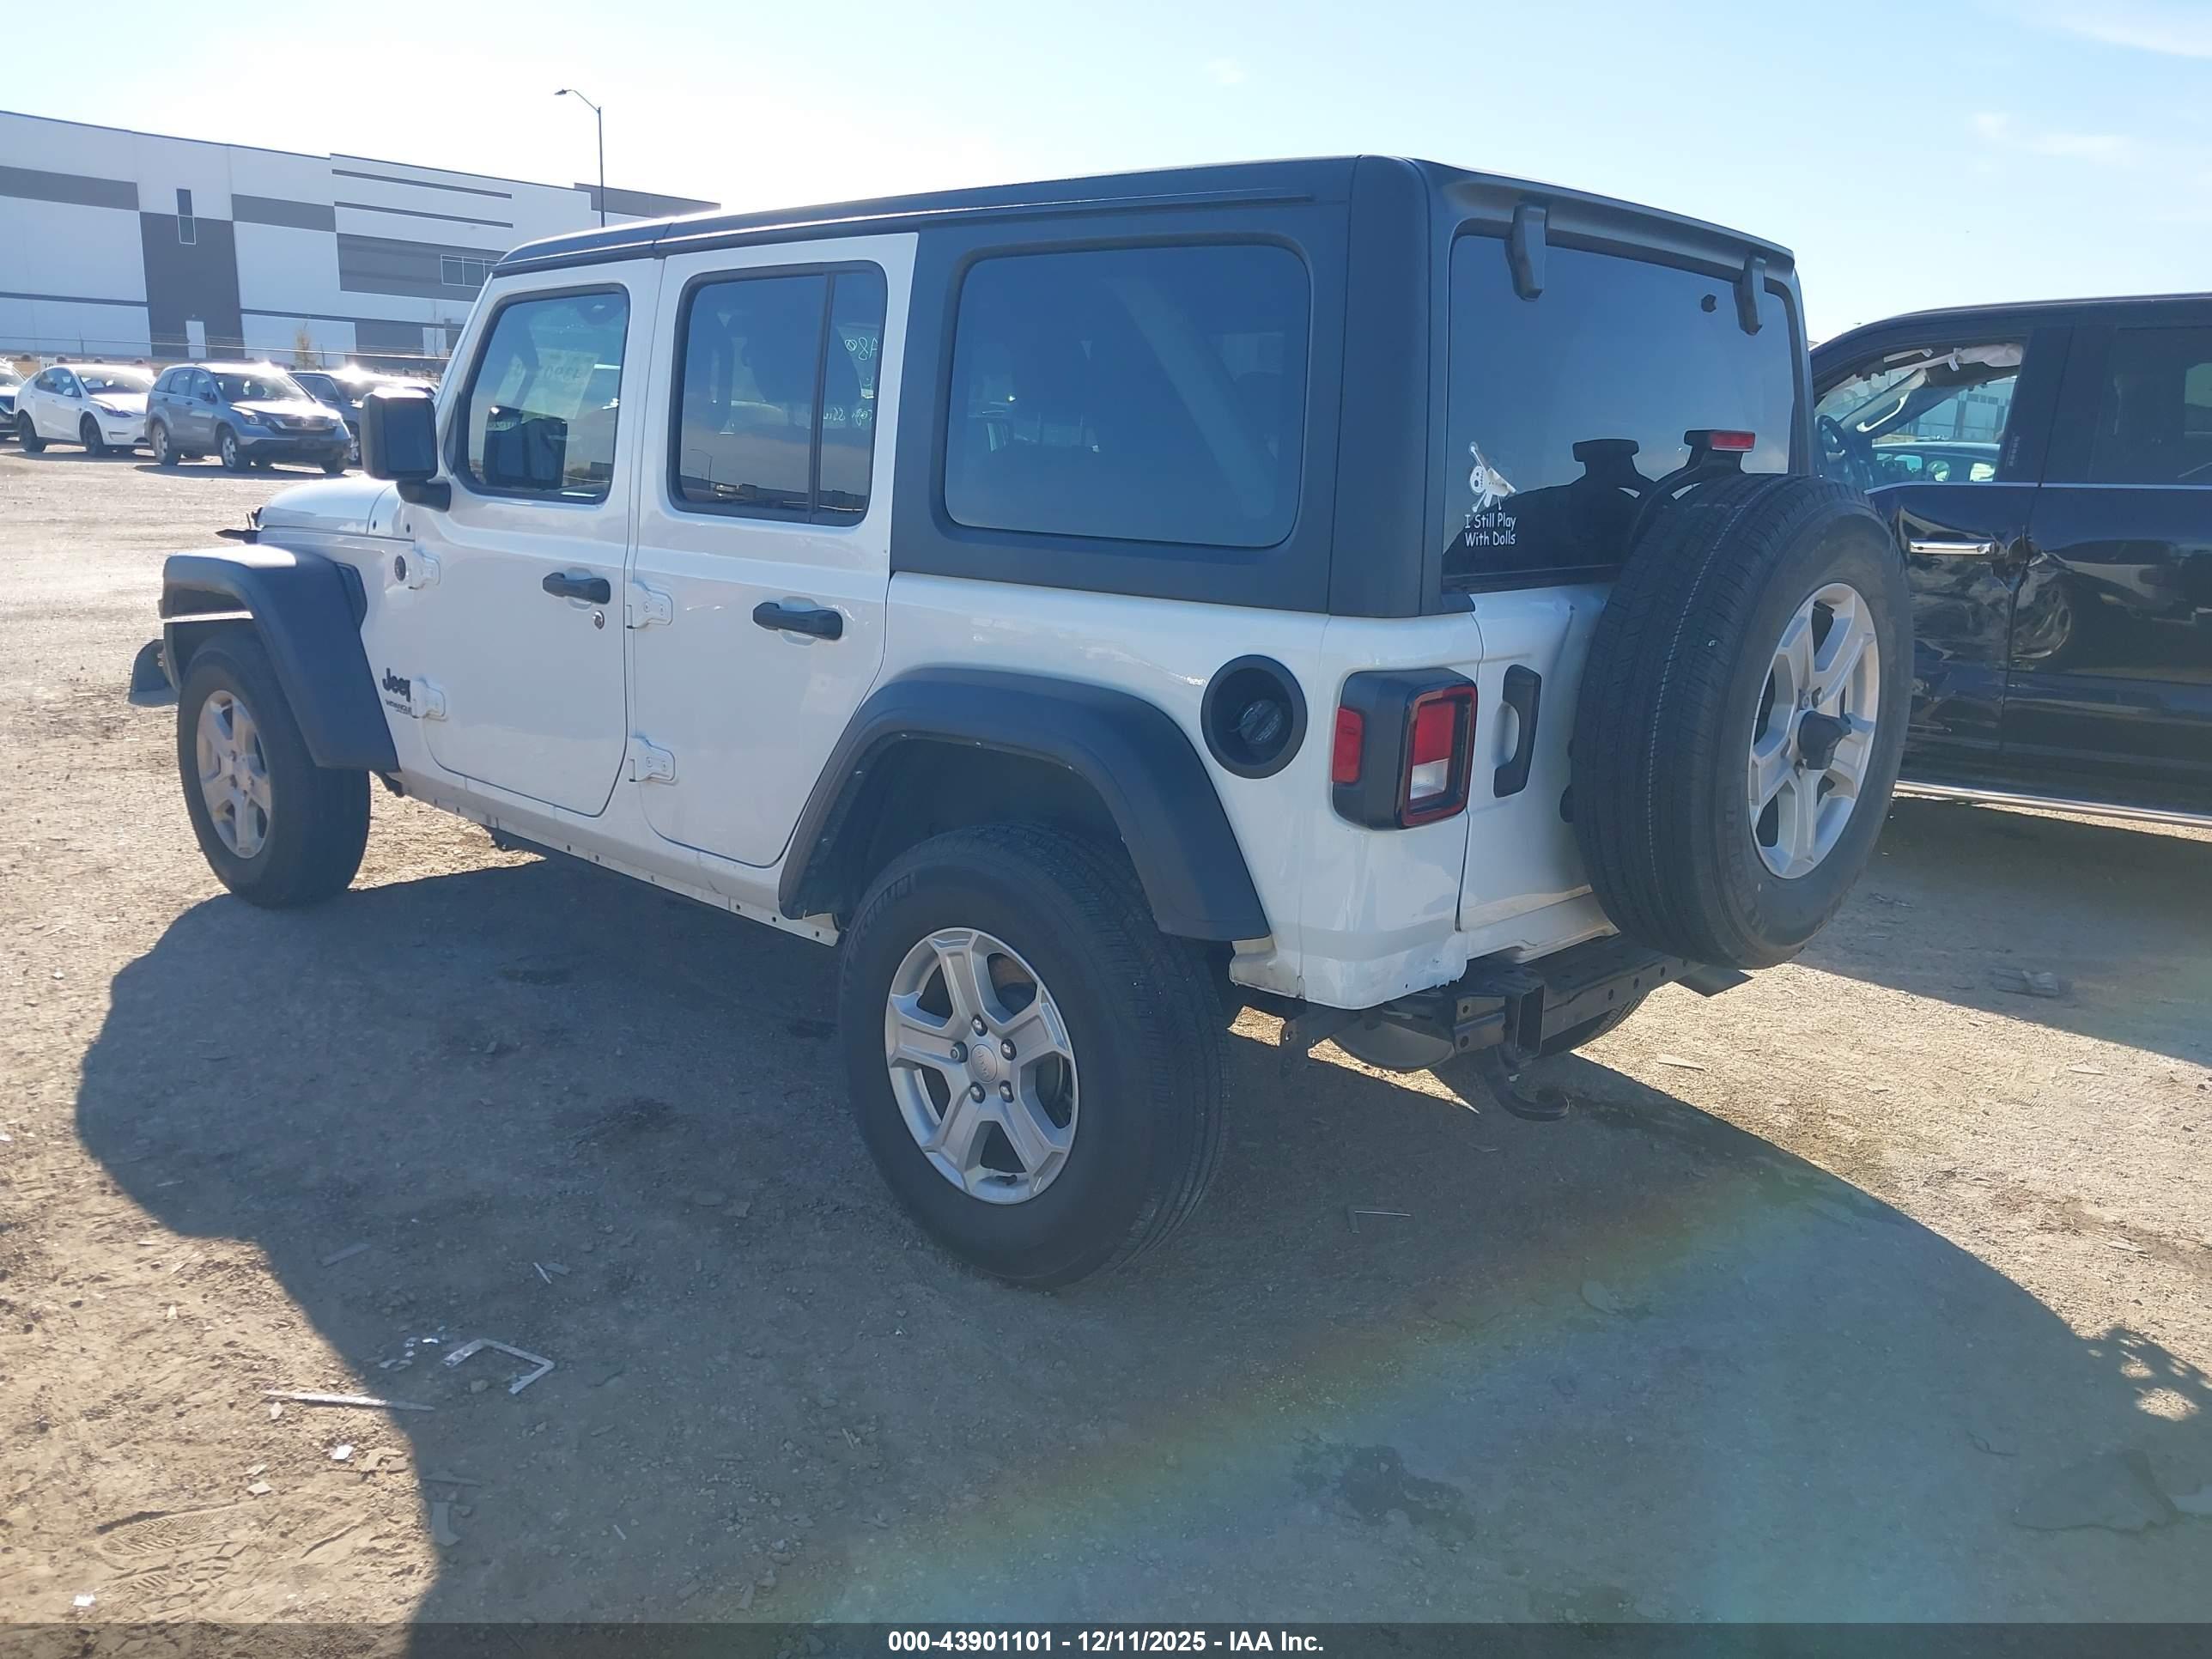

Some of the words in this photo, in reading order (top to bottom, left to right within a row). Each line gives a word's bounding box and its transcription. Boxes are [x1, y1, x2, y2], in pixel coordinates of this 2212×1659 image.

[1464, 514, 1471, 529] I
[1474, 513, 1495, 529] Still
[1497, 512, 1516, 532] Play
[1464, 531, 1490, 547] With
[1492, 530, 1516, 546] Dolls
[382, 667, 411, 702] Jeep
